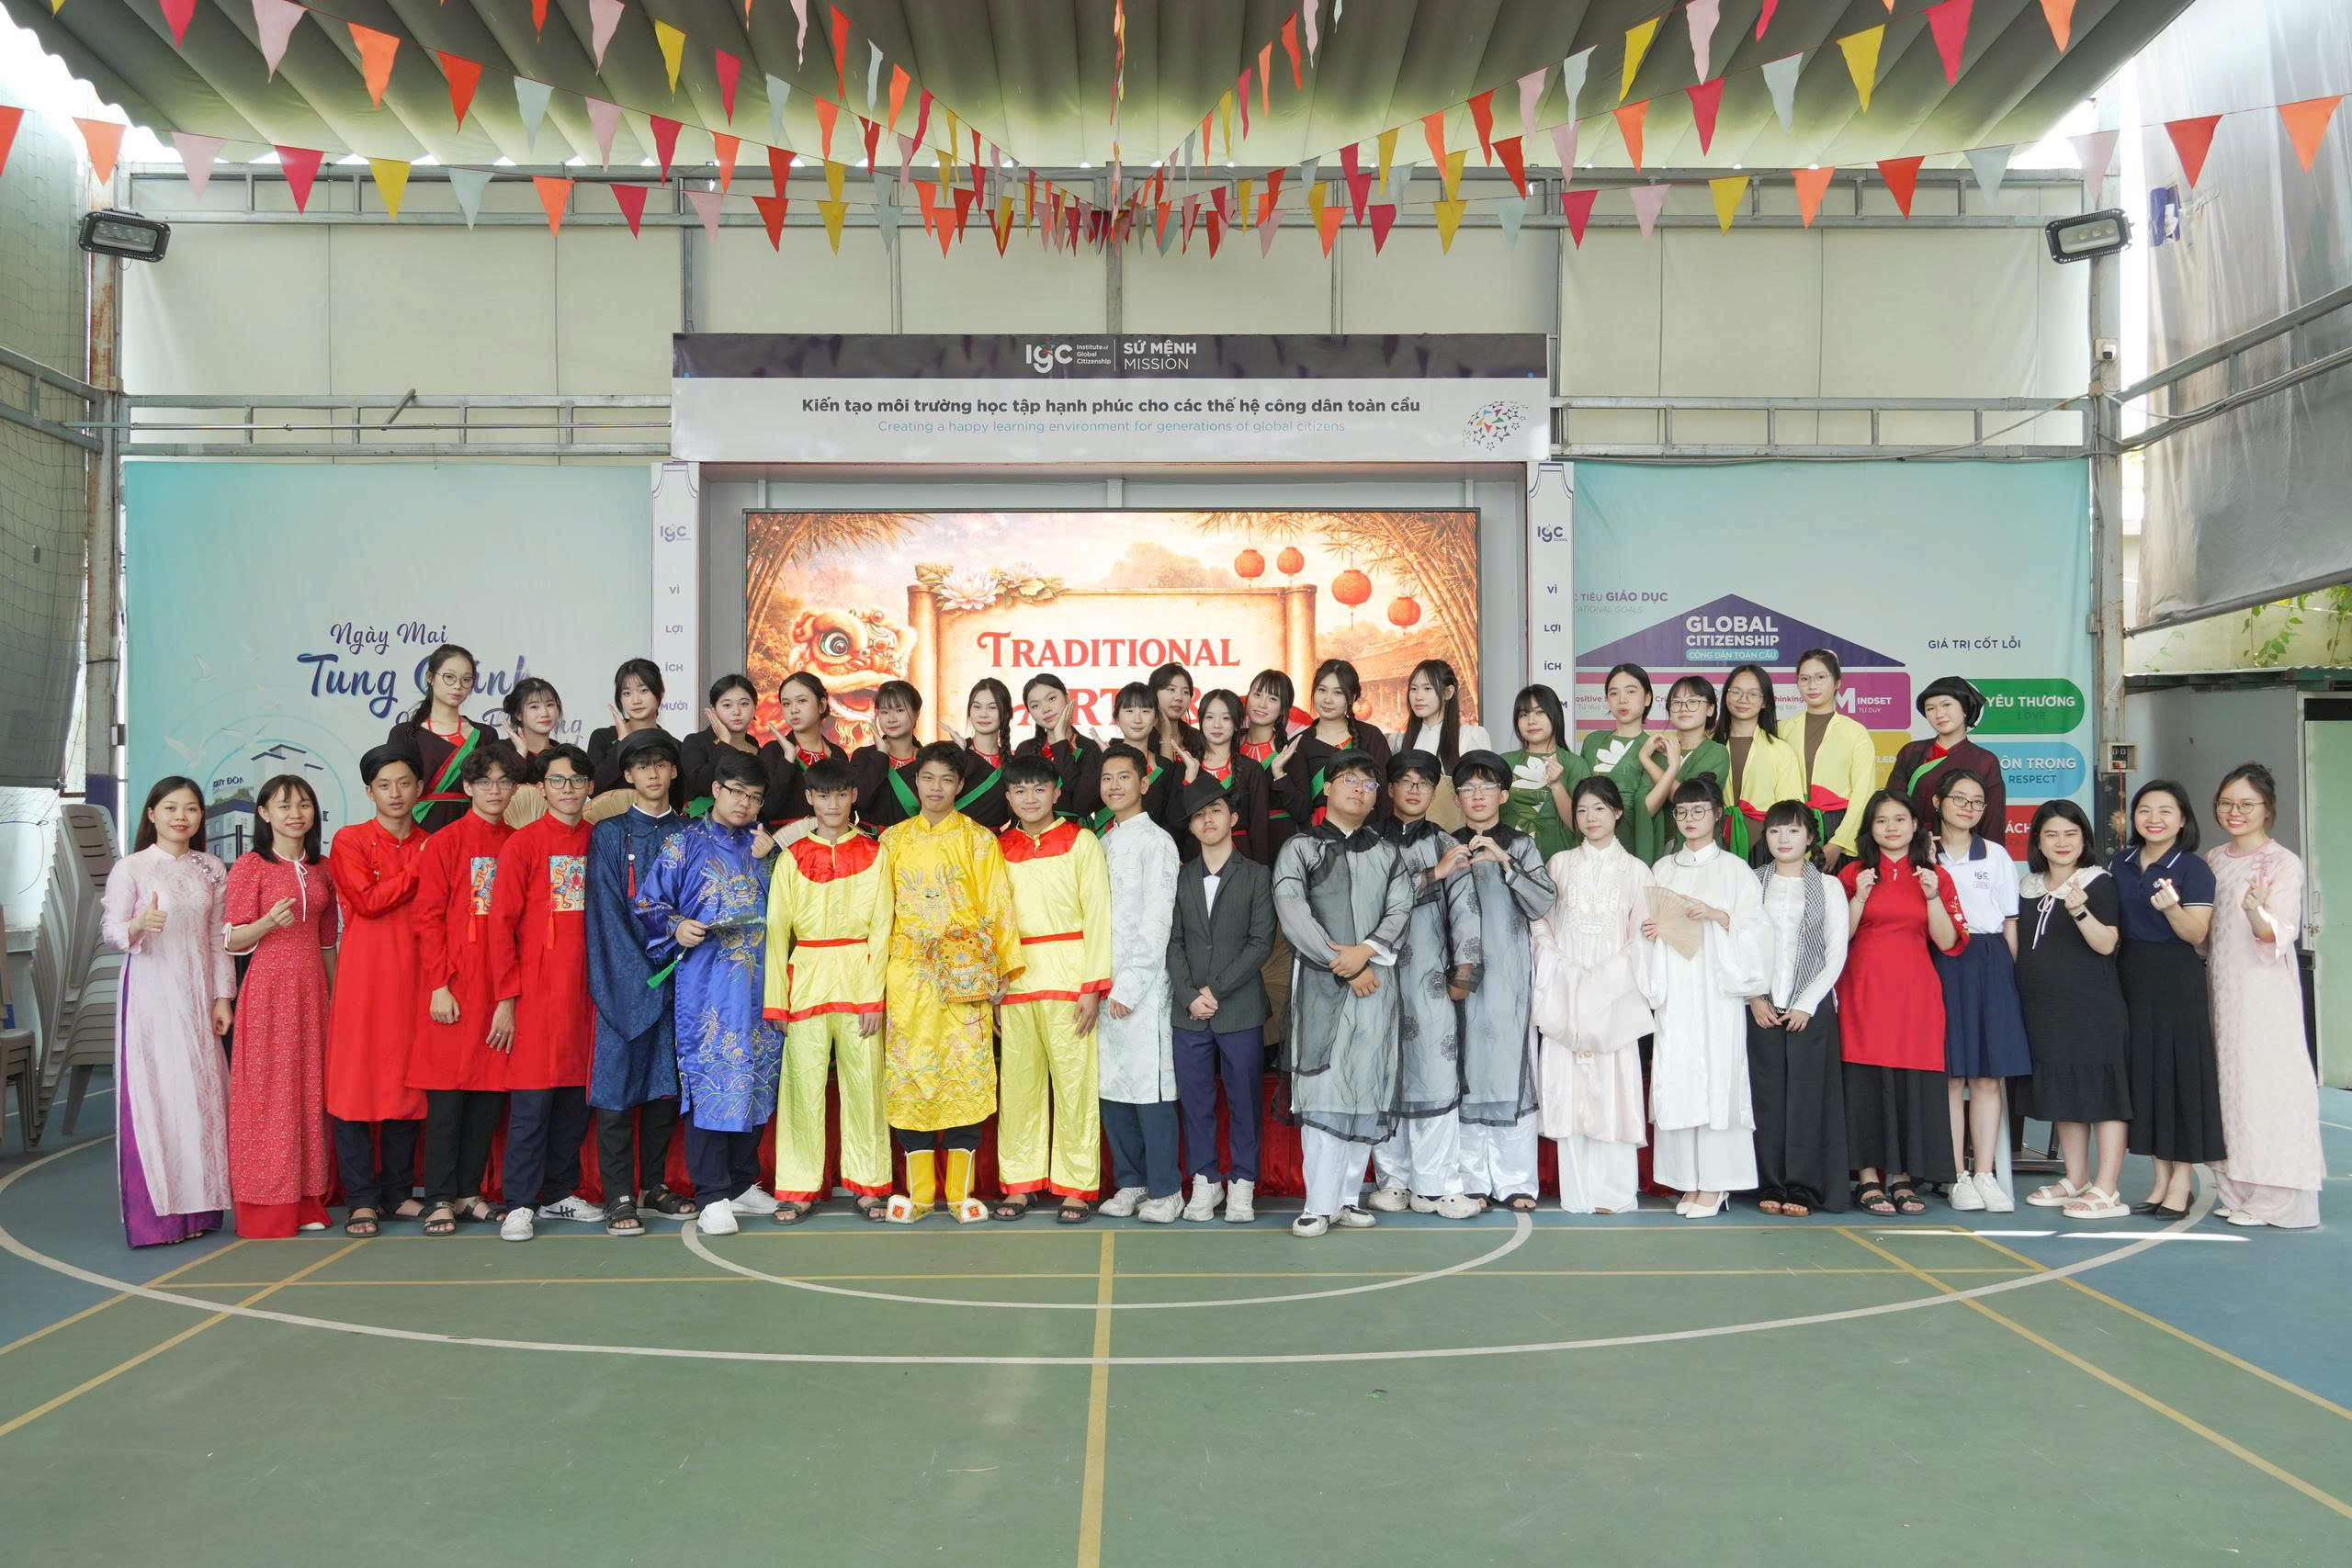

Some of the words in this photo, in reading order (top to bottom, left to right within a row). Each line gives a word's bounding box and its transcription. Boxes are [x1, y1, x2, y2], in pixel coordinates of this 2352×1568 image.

[1124, 340, 1147, 355] SỨ
[1150, 340, 1197, 357] MỆNH
[1124, 358, 1189, 370] MISSION
[802, 397, 840, 412] Kiến
[844, 400, 873, 414] tạo
[877, 399, 910, 412] môi
[914, 399, 972, 414] trường
[978, 400, 1008, 415] học
[1012, 399, 1041, 415] tập
[1046, 400, 1087, 415] hạnh
[1092, 399, 1134, 414] phúc
[1138, 400, 1169, 412] cho
[1174, 399, 1203, 412] các
[1207, 397, 1237, 412] thế
[1240, 399, 1261, 415] hệ
[1264, 399, 1306, 414] công
[1311, 399, 1343, 412] dân
[1348, 399, 1385, 412] toàn
[1391, 397, 1420, 412] cầu
[878, 421, 933, 434] Creating
[937, 423, 945, 432] a
[949, 421, 989, 434] happy
[993, 421, 1045, 434] learning
[1049, 422, 1130, 432] environment
[1135, 421, 1153, 432] for
[1157, 422, 1232, 434] generations
[1236, 421, 1250, 432] of
[1253, 421, 1293, 434] global
[1296, 422, 1345, 432] citizens
[669, 584, 680, 594] VÌ
[1547, 584, 1557, 594] VÌ
[1580, 592, 1602, 602] TIÊU
[1606, 590, 1637, 602] GIÁO
[1641, 592, 1668, 604] DỤC
[1544, 624, 1561, 635] LỢI
[1686, 615, 1779, 633] GLOBAL
[665, 625, 684, 636] LỢI
[330, 621, 390, 655] Ngày
[396, 621, 448, 644] Mai
[1686, 635, 1780, 647] CITIZENSHIP
[1928, 637, 1949, 649] GIÁ
[1952, 640, 1970, 651] TRỊ
[1973, 637, 1998, 649] CỐT
[977, 631, 1240, 667] TRADITIONAL
[665, 660, 684, 672] ÍCH
[1544, 659, 1562, 671] ÍCH
[297, 653, 398, 718] Tung
[1575, 694, 1602, 703] ositive
[1775, 695, 1804, 704] hinking
[1985, 694, 2014, 707] YÊU
[2018, 694, 2075, 707] THƯƠNG
[661, 699, 688, 711] MƯỜI
[2017, 712, 2046, 720] LOVE
[1999, 755, 2022, 770] ÔN
[2027, 757, 2076, 773] TRỌNG
[2008, 774, 2057, 784] RESPECT
[2005, 820, 2030, 834] ÁCH
